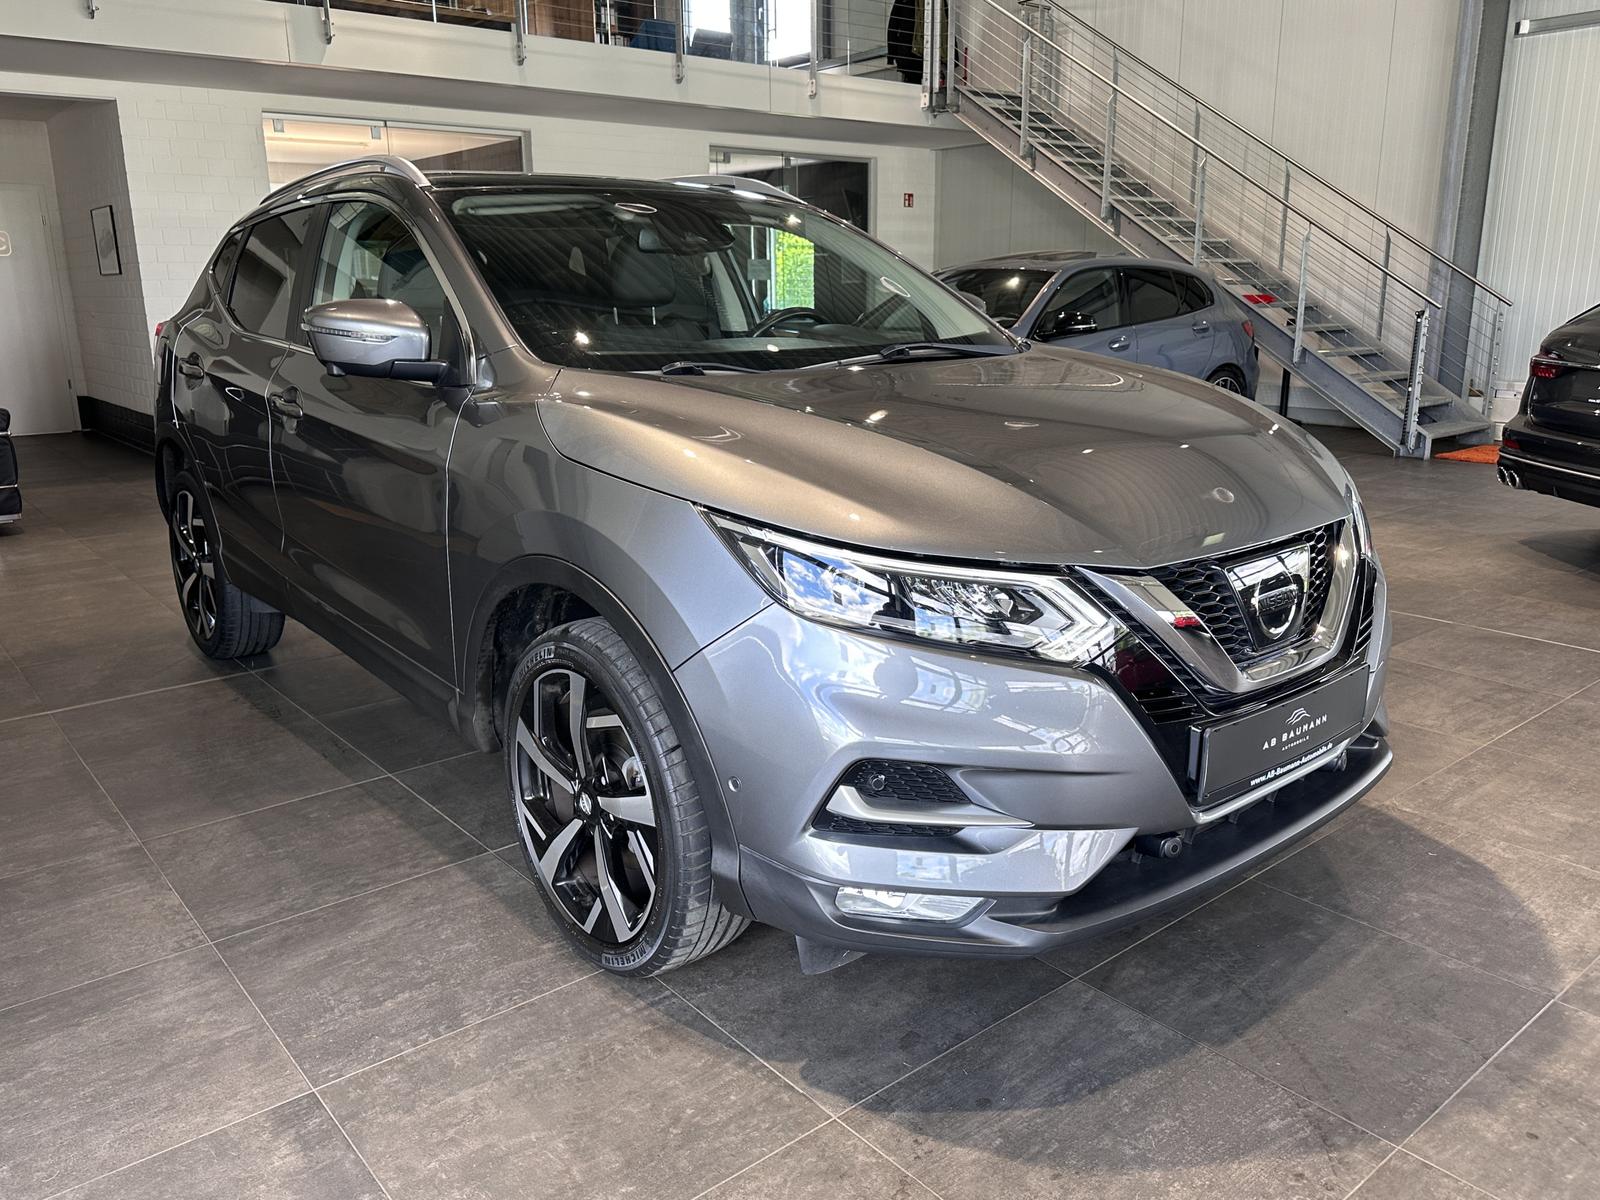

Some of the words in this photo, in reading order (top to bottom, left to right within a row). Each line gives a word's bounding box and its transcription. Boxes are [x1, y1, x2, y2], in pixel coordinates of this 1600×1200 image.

[1259, 589, 1296, 611] NISSAN
[1262, 737, 1277, 750] AB
[1282, 713, 1328, 742] BAUMANN
[603, 943, 647, 966] MICHELIN
